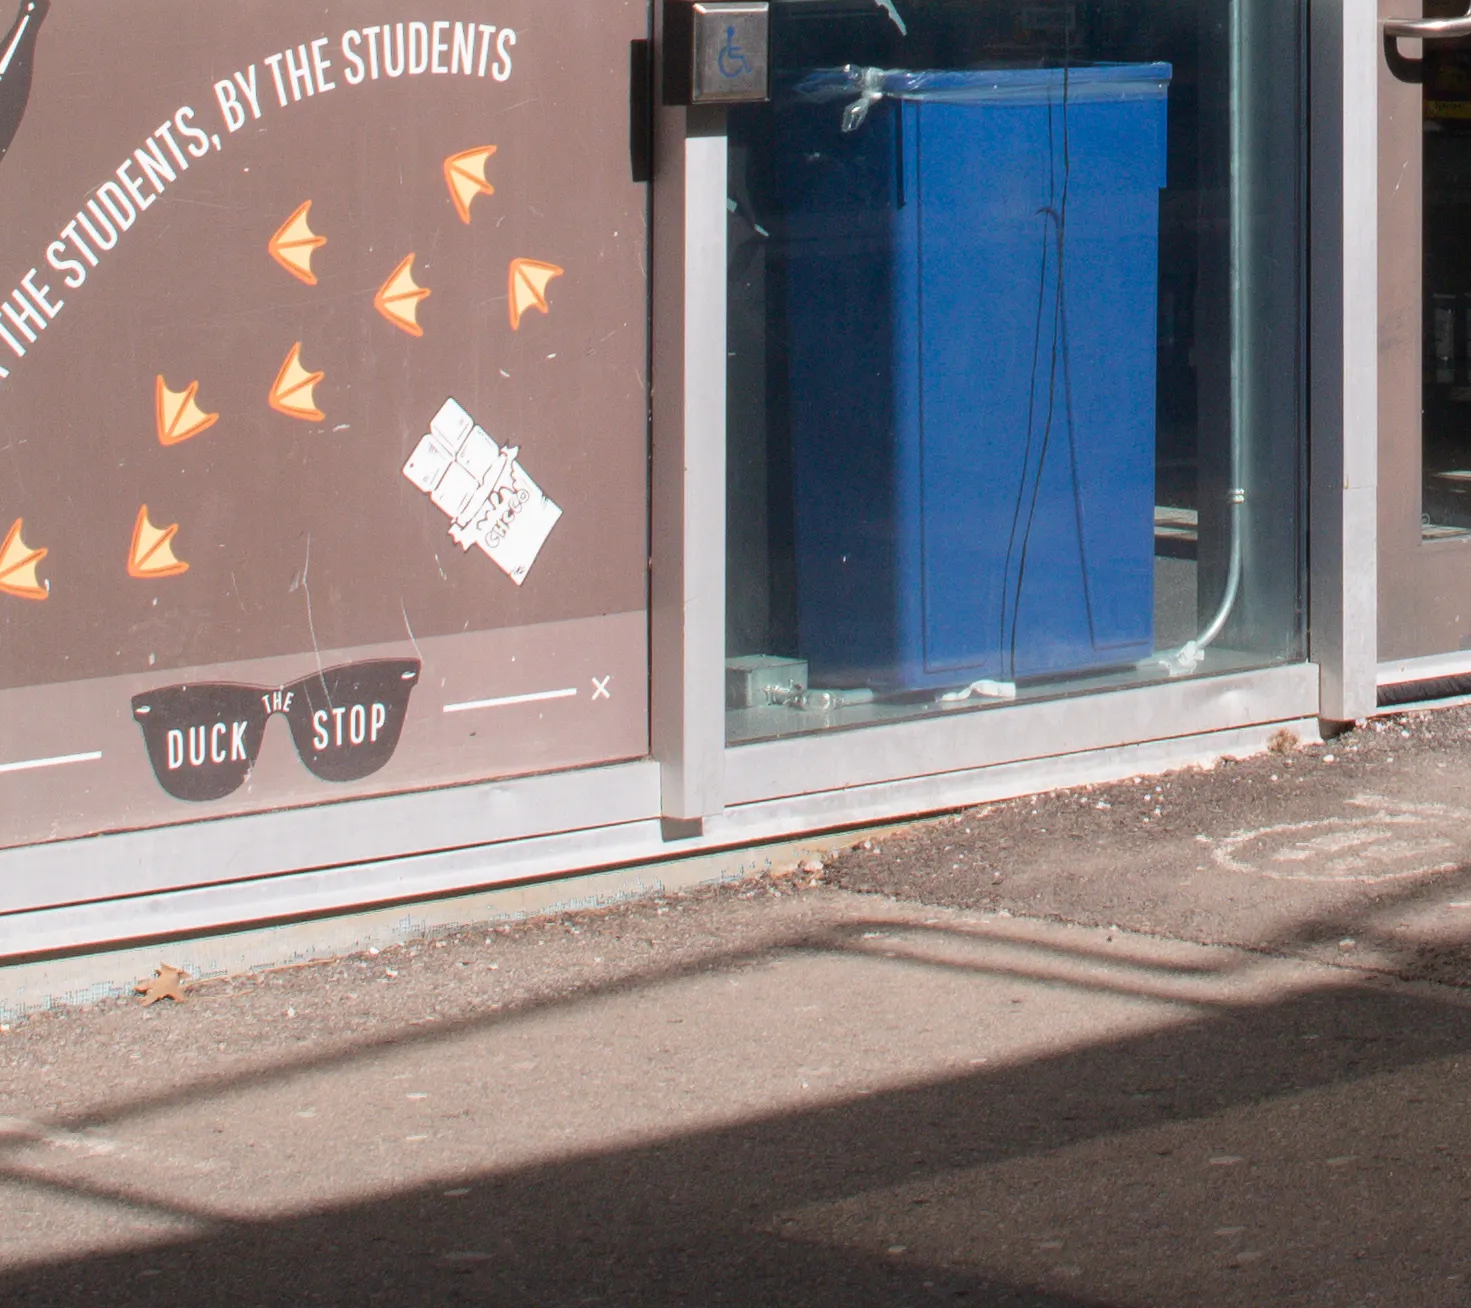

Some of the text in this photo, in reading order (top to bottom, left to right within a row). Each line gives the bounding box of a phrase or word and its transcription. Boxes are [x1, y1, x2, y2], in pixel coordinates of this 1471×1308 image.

[46, 105, 222, 289] STUDENTS,
[213, 64, 261, 134] BY
[264, 37, 336, 108] THE
[341, 20, 517, 85] STUDENTS
[167, 702, 387, 770] DUCK STOP
[262, 689, 294, 715] THE
